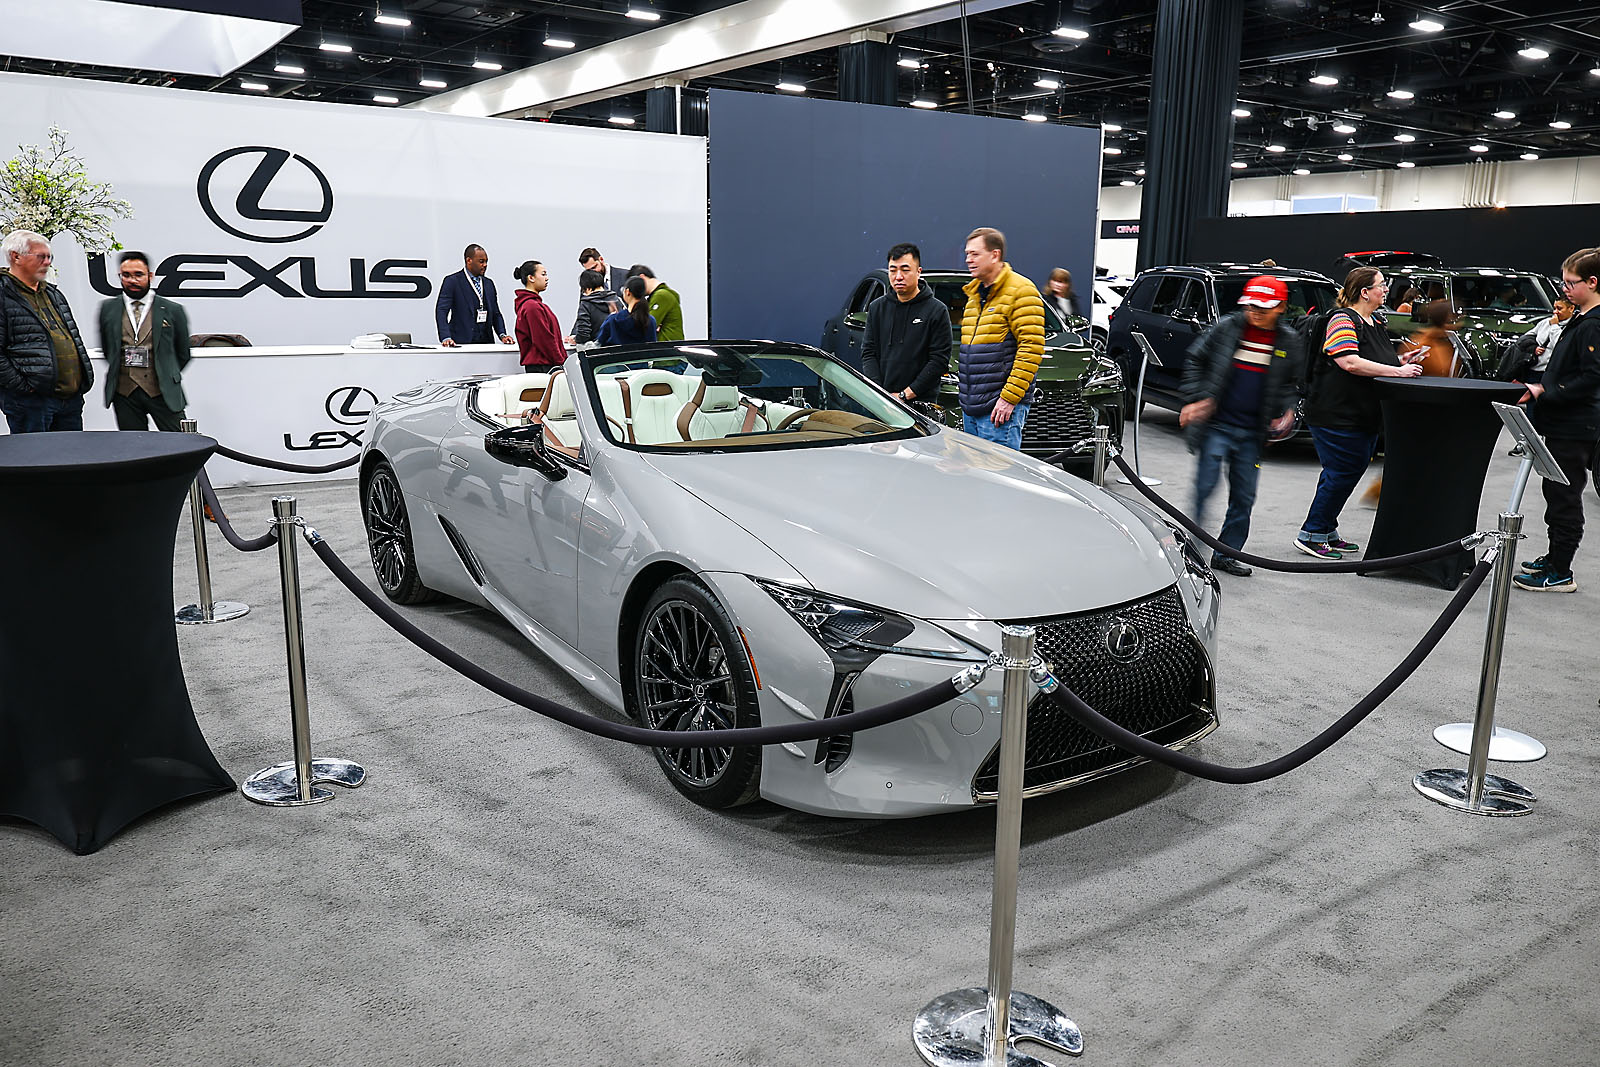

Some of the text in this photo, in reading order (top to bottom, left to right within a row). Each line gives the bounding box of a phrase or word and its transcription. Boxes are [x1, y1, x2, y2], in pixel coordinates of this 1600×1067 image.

[1116, 225, 1140, 234] GM
[88, 251, 433, 299] LEXUS
[283, 430, 365, 451] LEX
